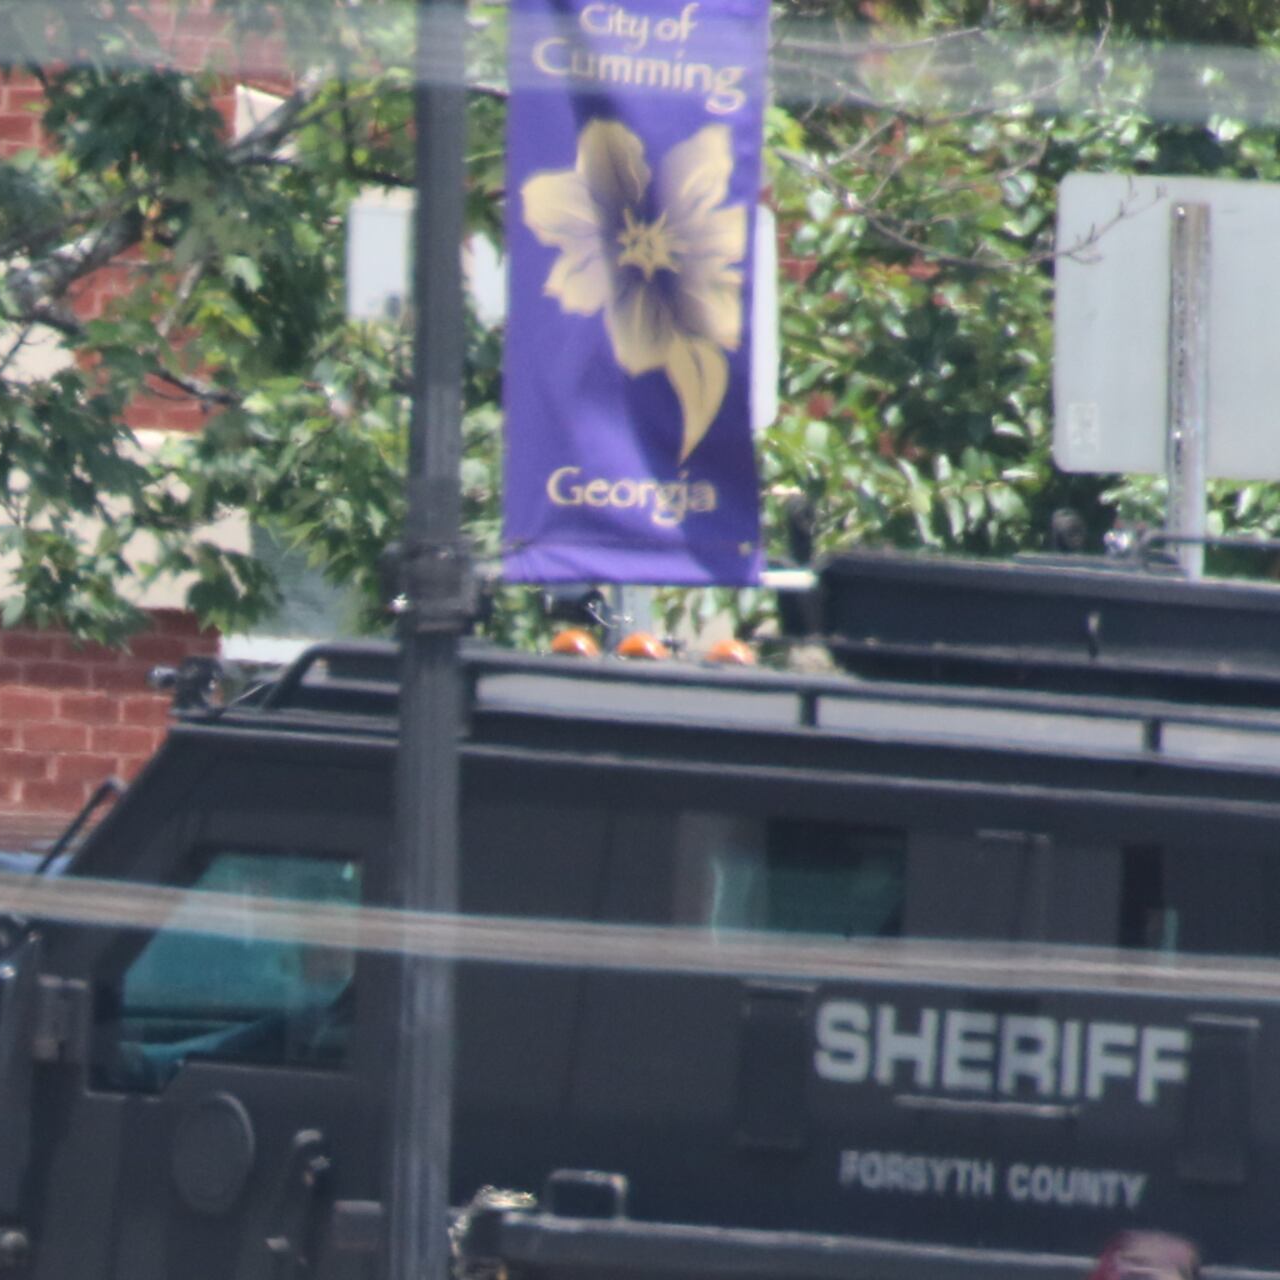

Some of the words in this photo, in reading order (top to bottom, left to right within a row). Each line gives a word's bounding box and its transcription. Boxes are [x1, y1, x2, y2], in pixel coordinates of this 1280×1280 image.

[579, 3, 649, 51] City
[654, 2, 699, 42] of
[532, 36, 747, 114] Cumming
[546, 466, 717, 527] Georgia
[813, 999, 1191, 1104] SHERIFF
[840, 1149, 995, 1197] FORSYTH
[1006, 1162, 1149, 1209] COUNTY
